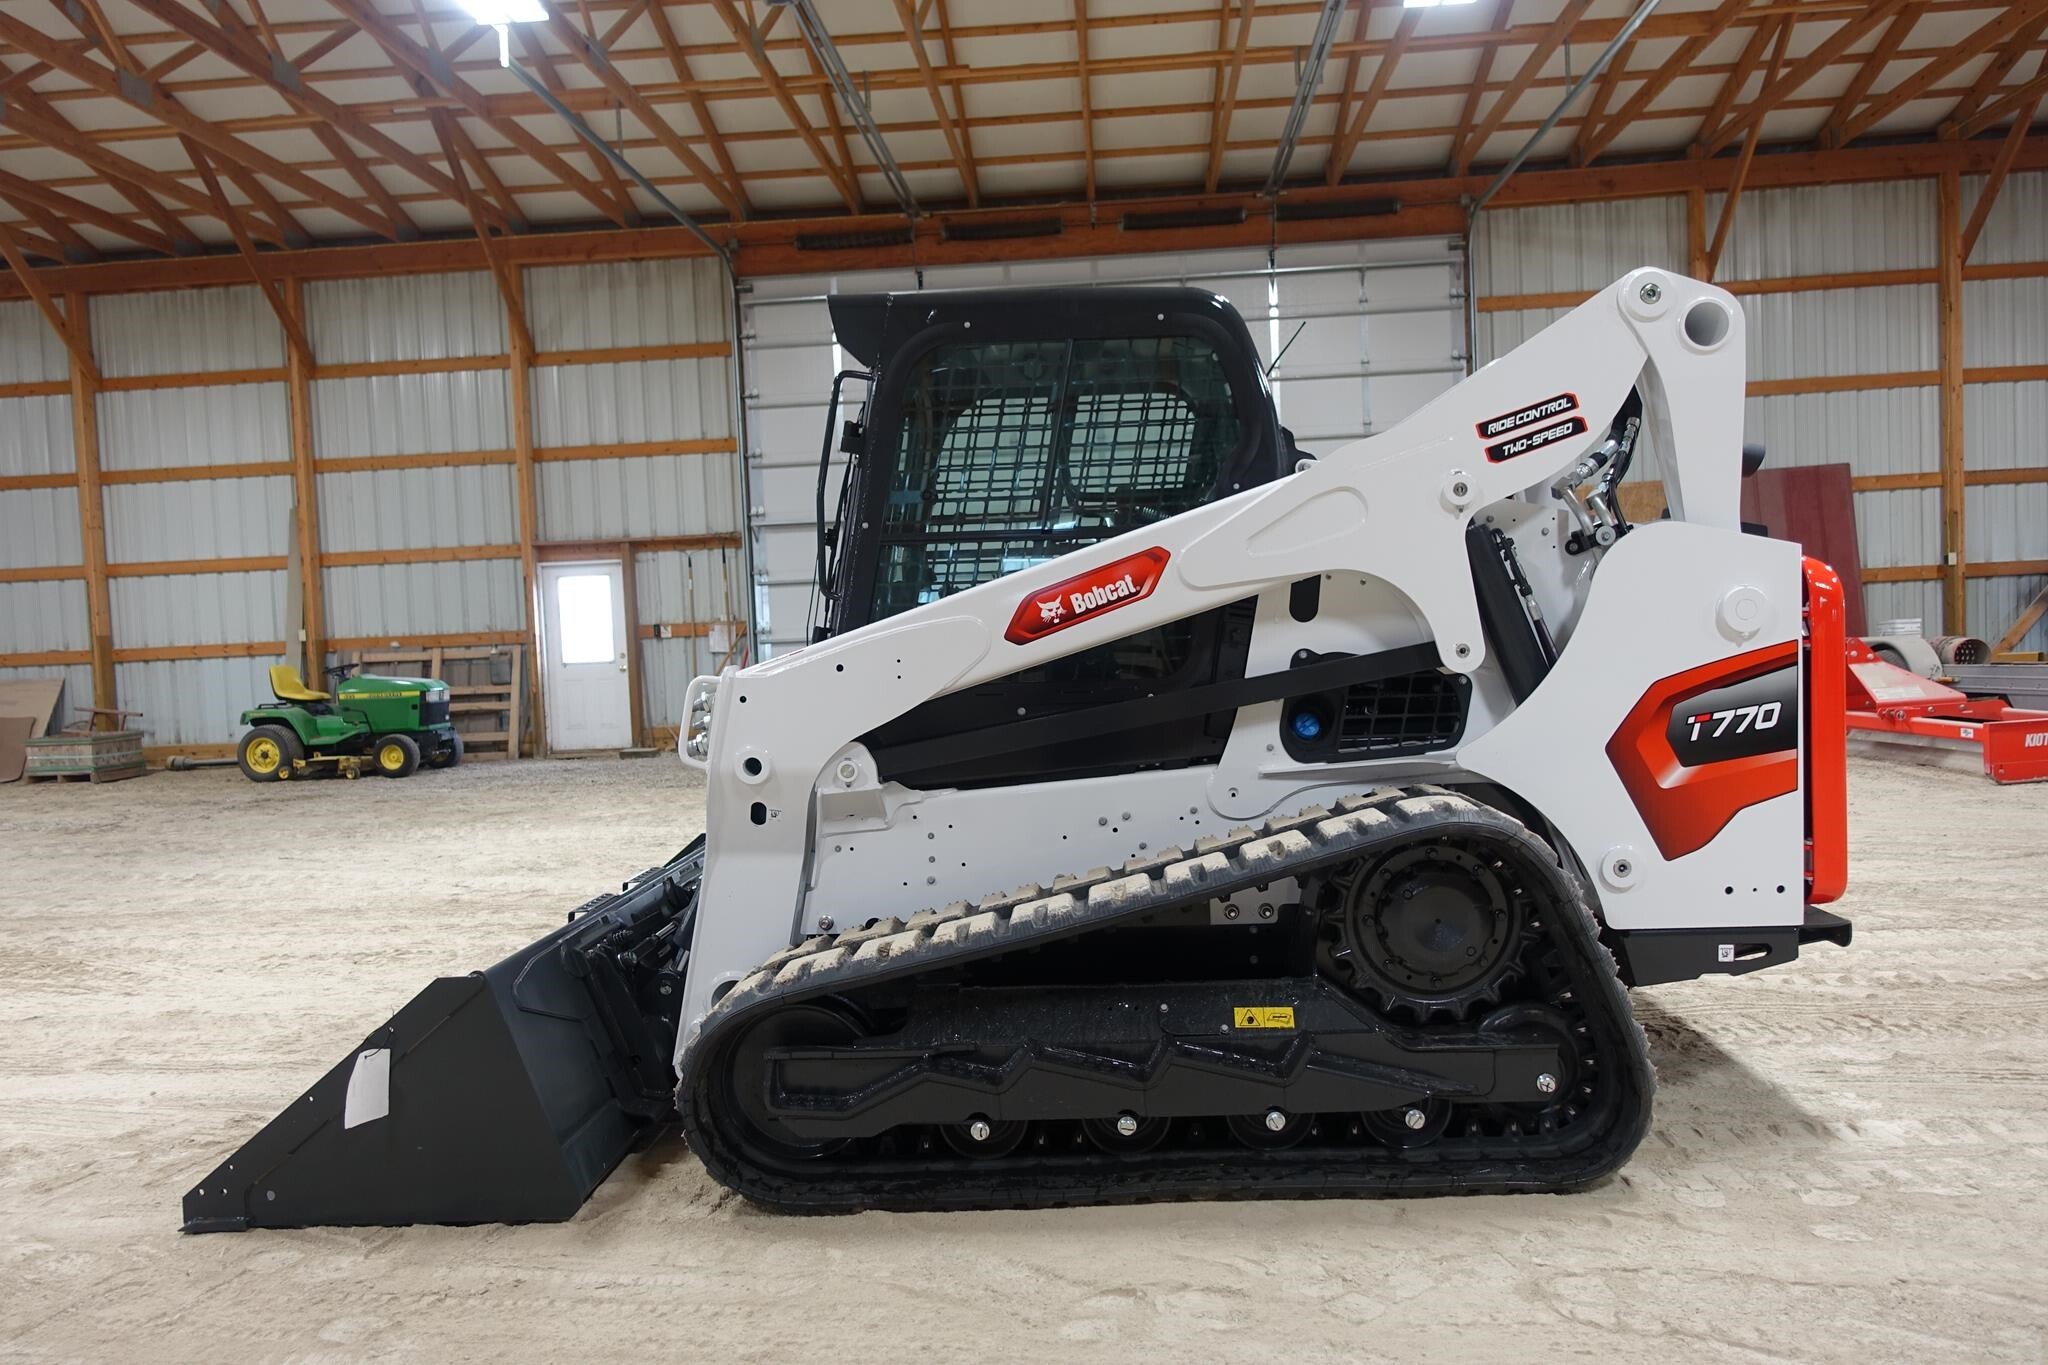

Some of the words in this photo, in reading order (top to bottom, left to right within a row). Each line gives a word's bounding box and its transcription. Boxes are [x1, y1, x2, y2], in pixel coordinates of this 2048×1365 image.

[1487, 415, 1515, 435] RIDE
[1515, 398, 1572, 426] CONTROL
[1502, 422, 1573, 456] TWO-SPEED
[1070, 574, 1137, 615] Bobcat
[1687, 701, 1782, 742] T770
